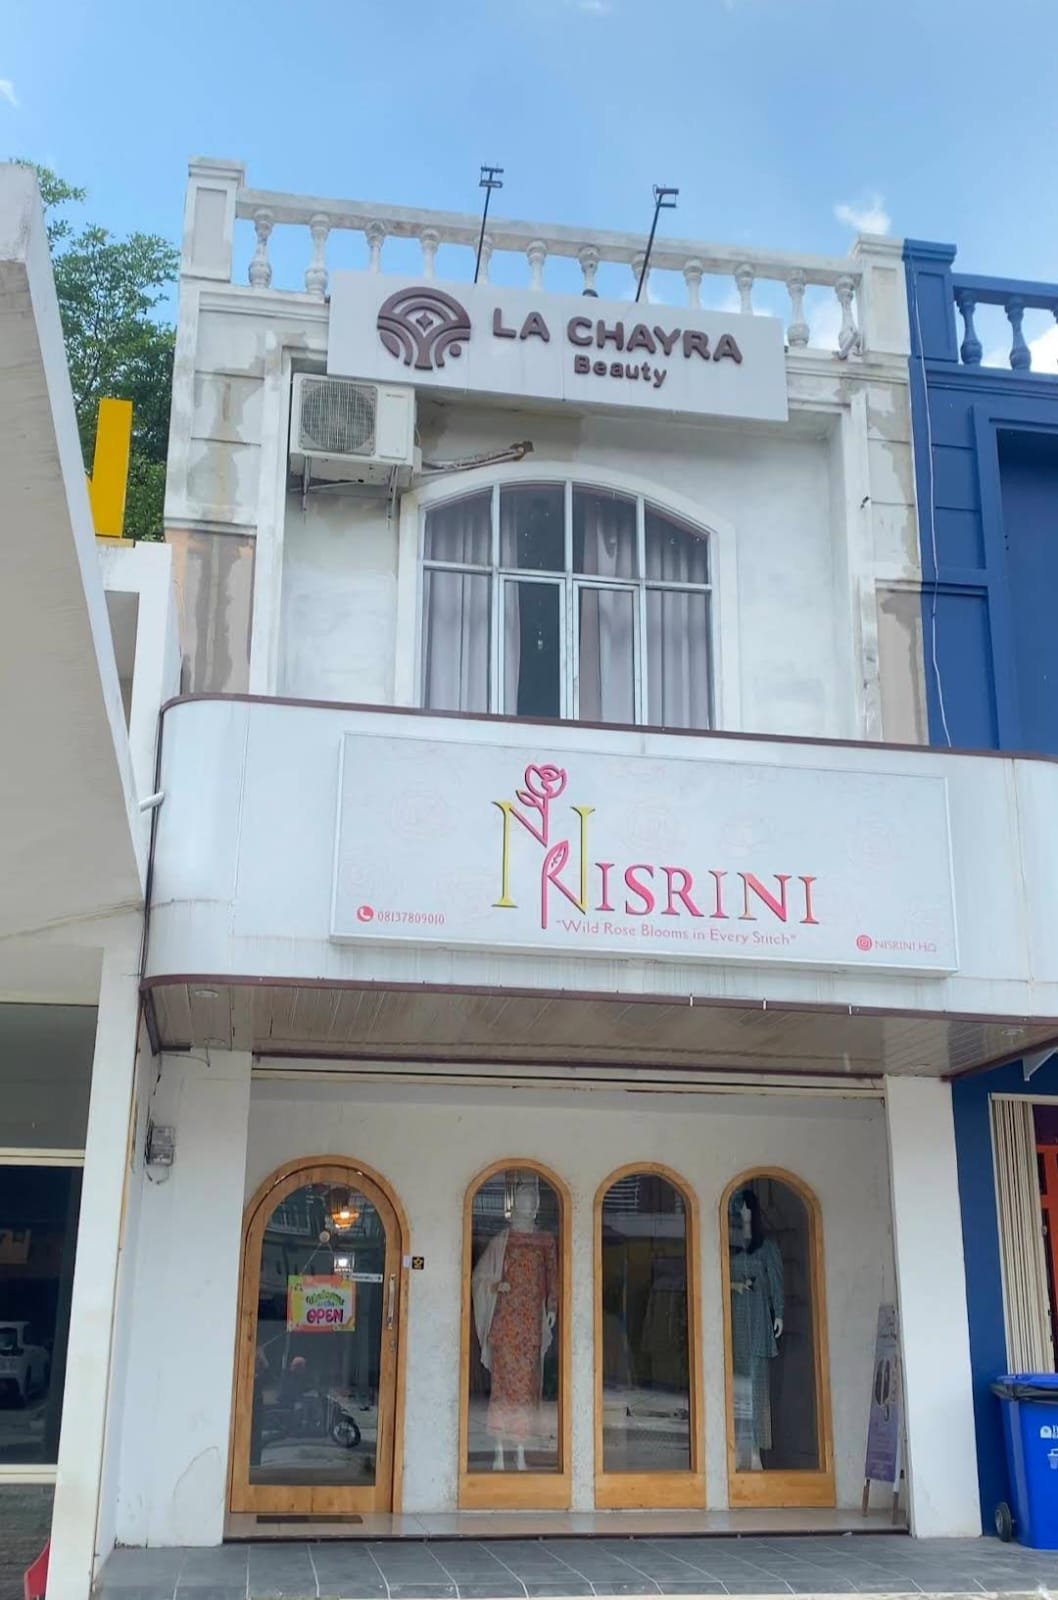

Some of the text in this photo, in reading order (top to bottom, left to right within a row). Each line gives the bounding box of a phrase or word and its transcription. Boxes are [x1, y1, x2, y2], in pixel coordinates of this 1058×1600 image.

[492, 307, 743, 365] LA CHAYRA
[573, 354, 668, 389] Beauty
[604, 922, 636, 936] Rose
[641, 923, 689, 939] Blooms
[692, 928, 705, 940] in
[710, 928, 749, 945] Every
[306, 1308, 344, 1324] OPEN
